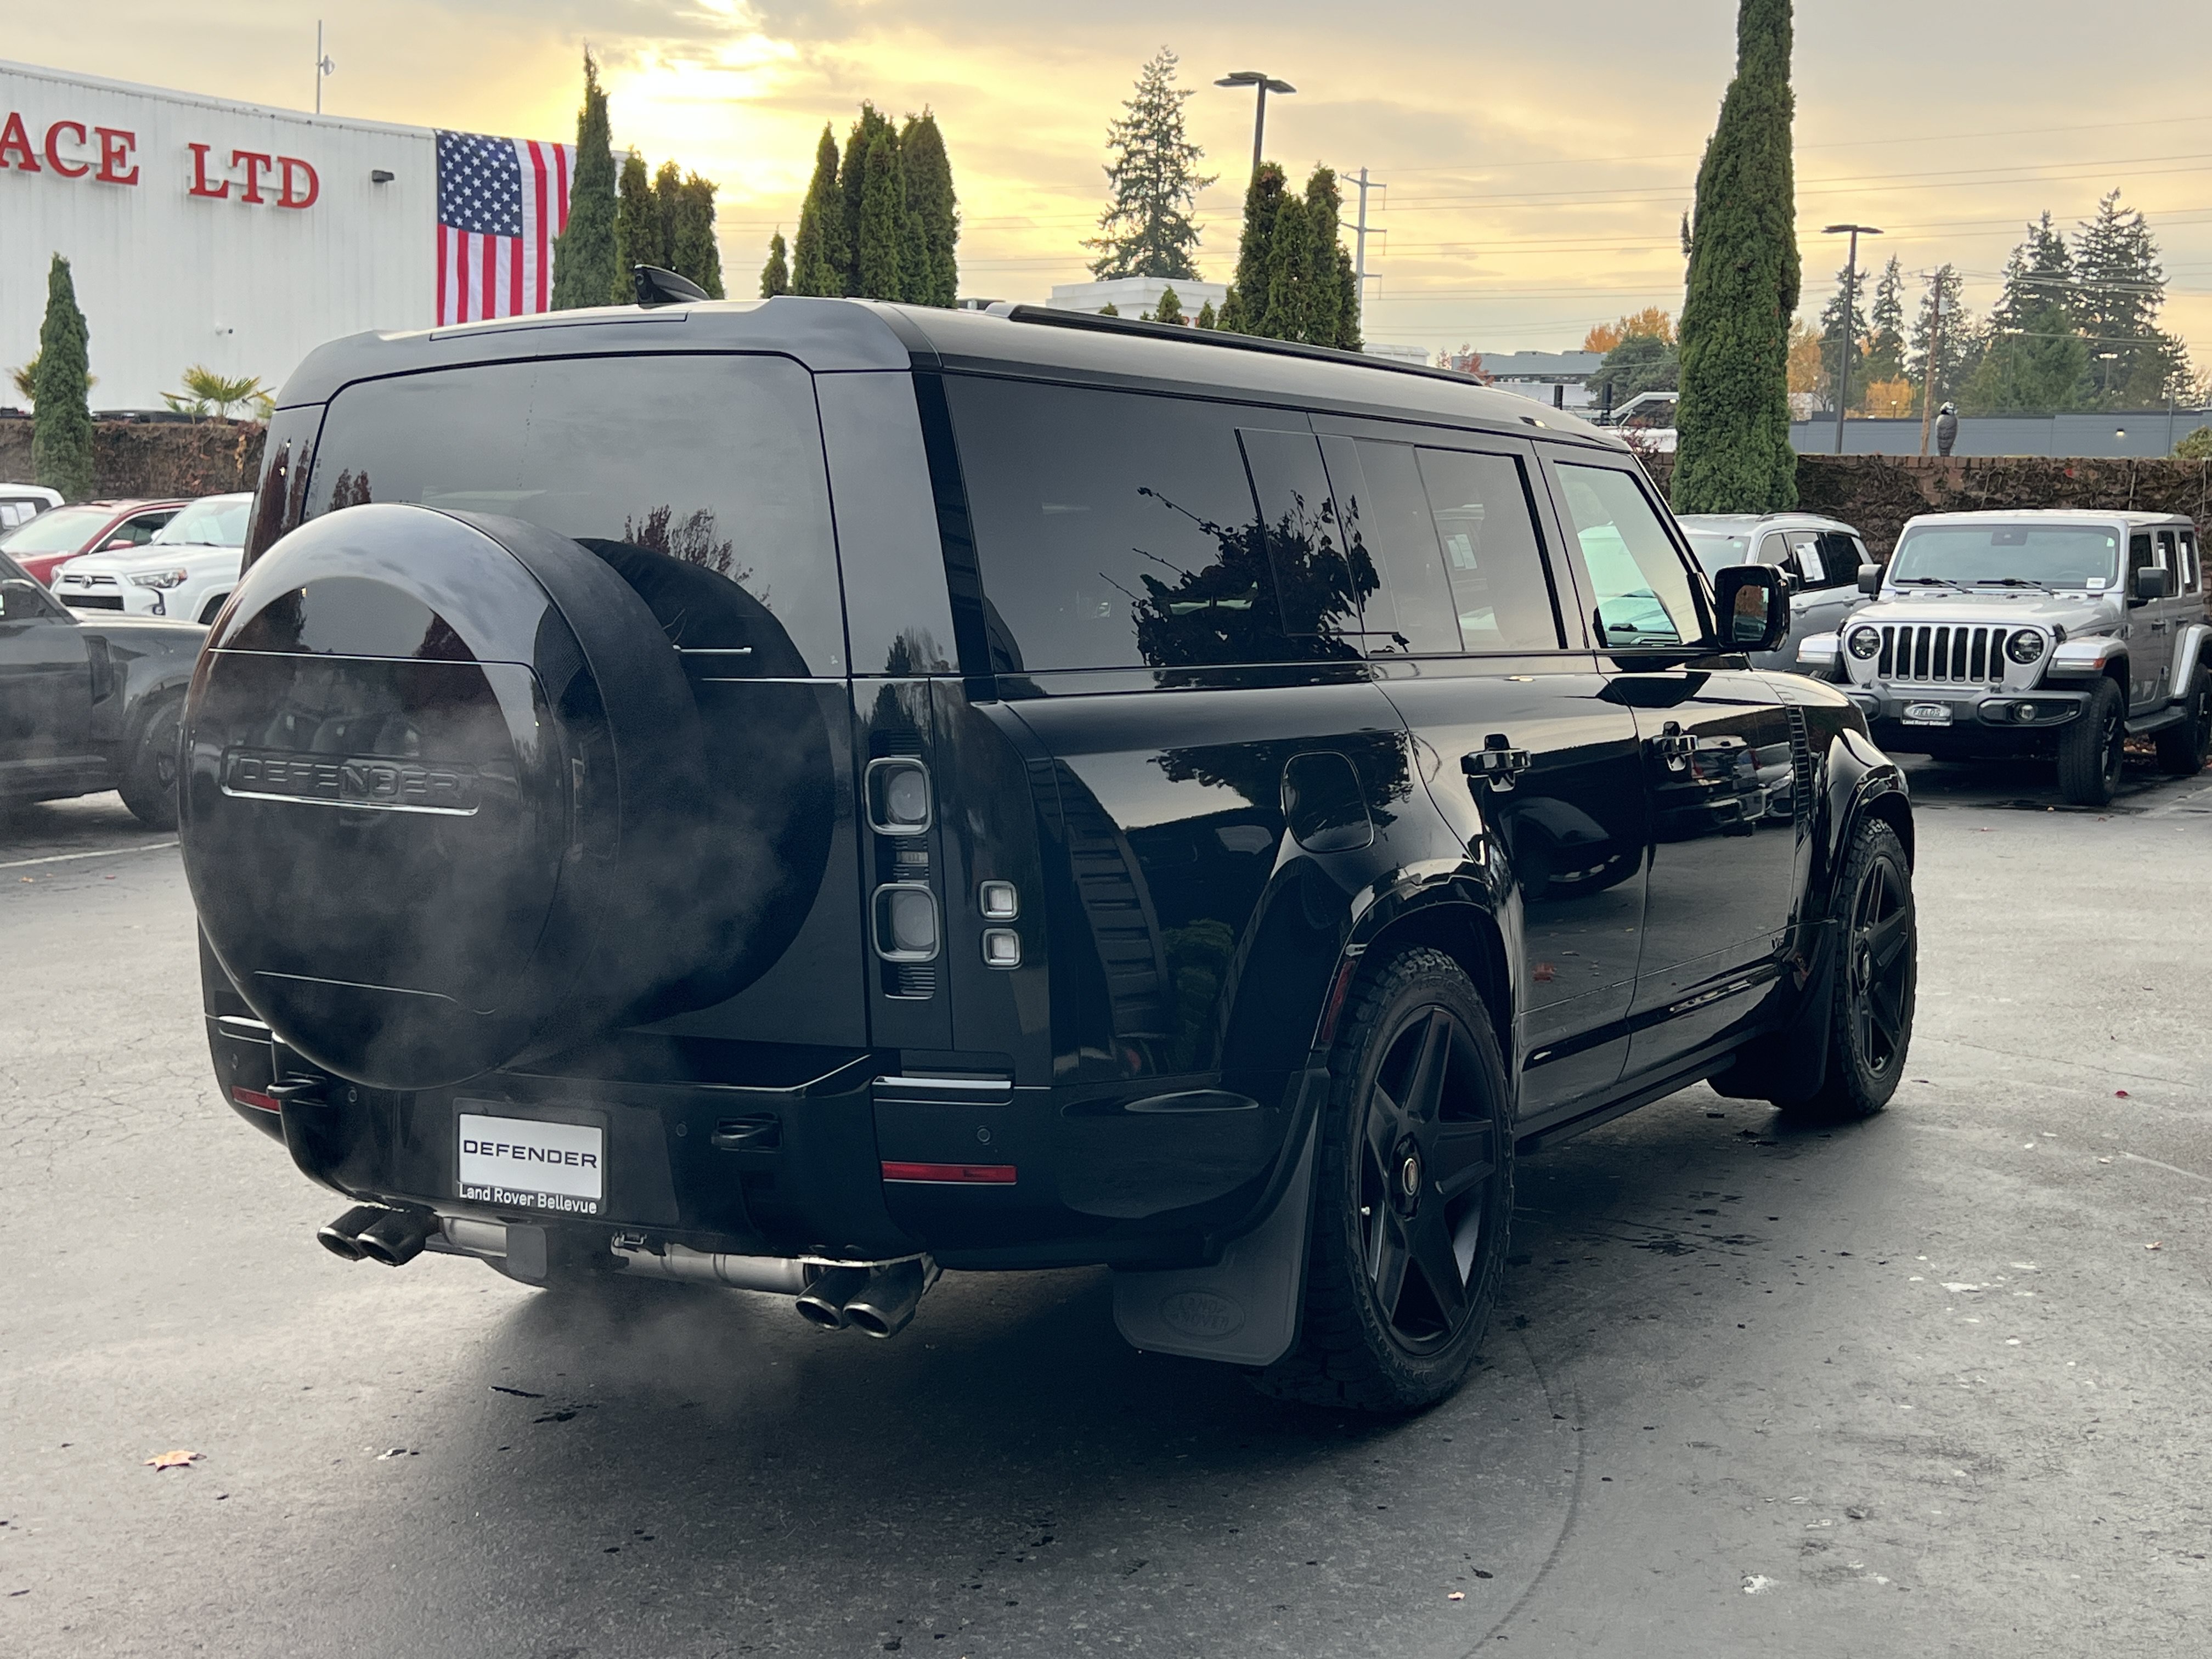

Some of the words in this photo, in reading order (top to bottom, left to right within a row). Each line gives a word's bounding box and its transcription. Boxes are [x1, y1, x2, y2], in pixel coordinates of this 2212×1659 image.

[188, 143, 319, 209] LTD
[239, 758, 462, 800] DEFENDER
[464, 1139, 597, 1169] DEFENDER
[459, 1183, 491, 1201] Land
[494, 1187, 535, 1206] Rover
[538, 1193, 597, 1214] Bellevue
